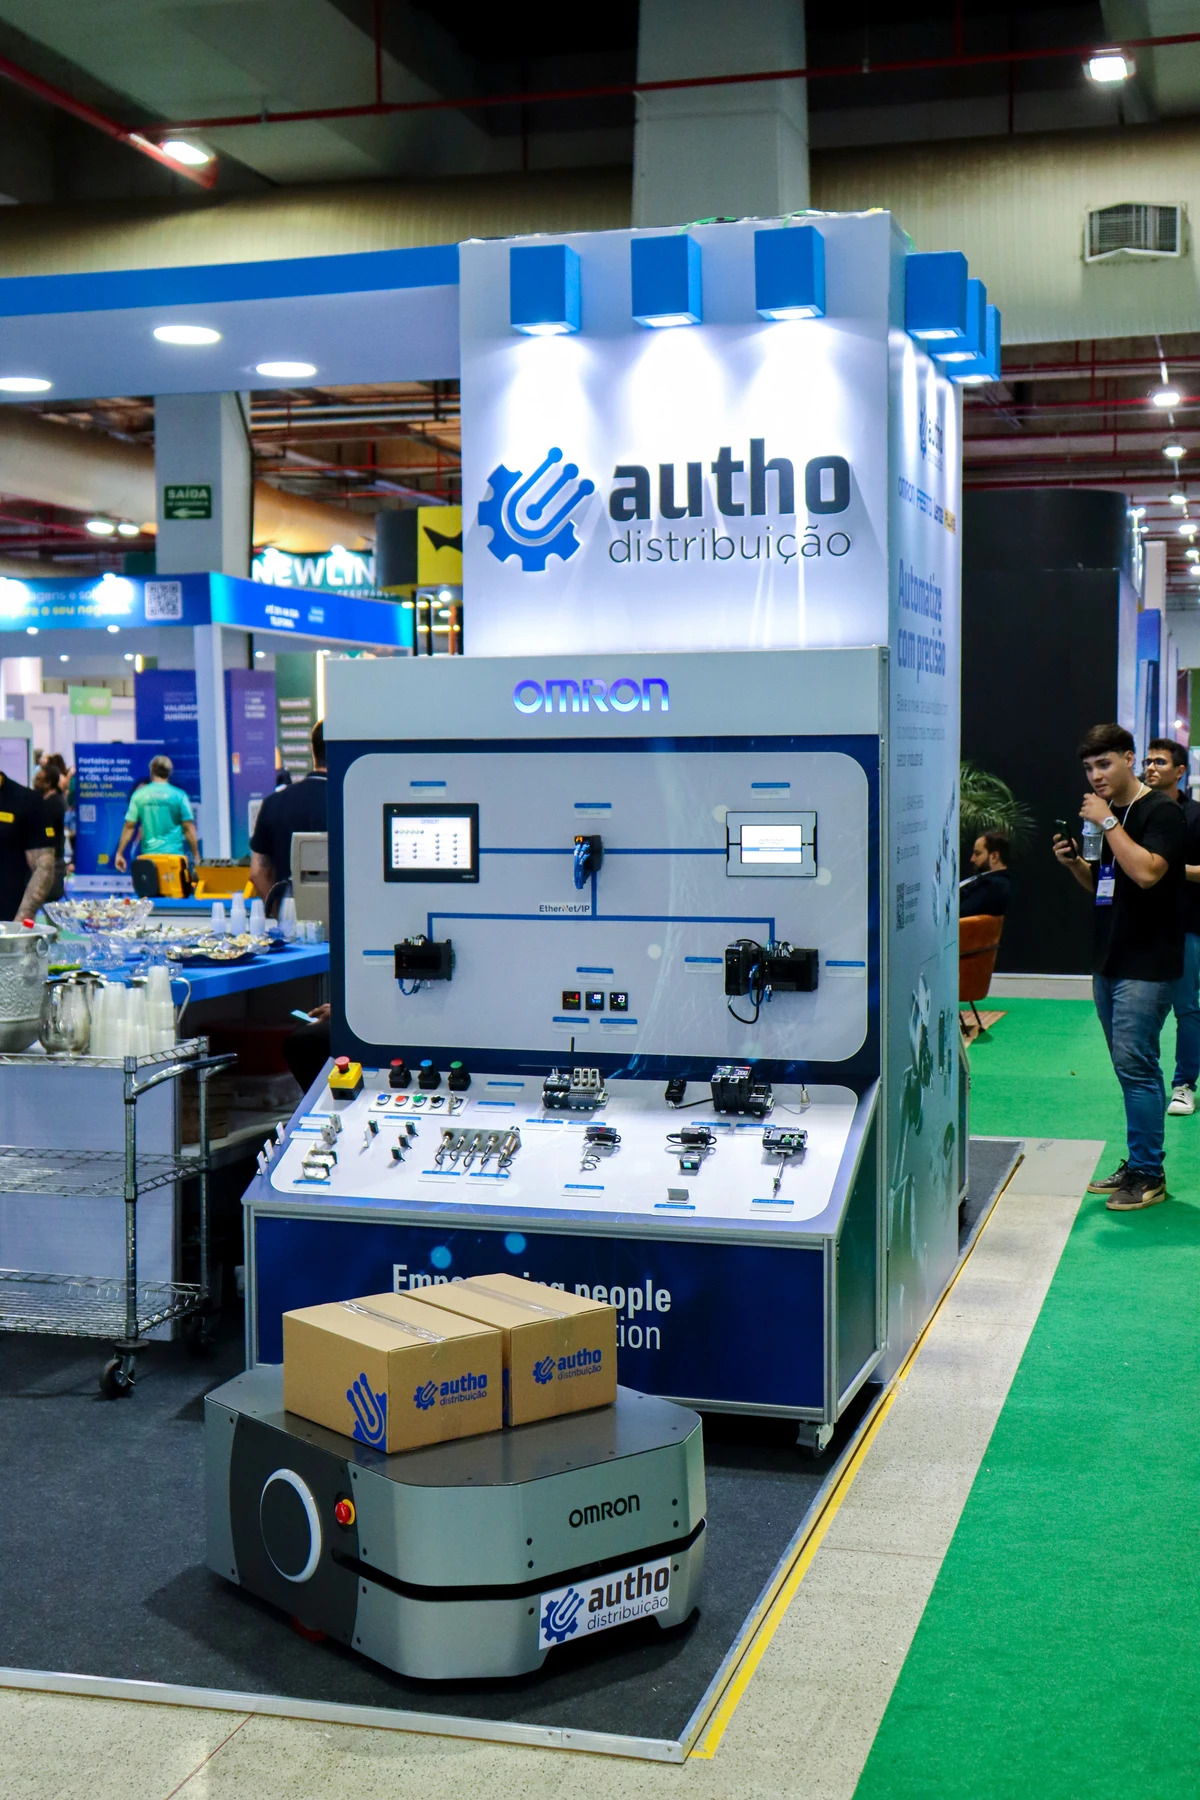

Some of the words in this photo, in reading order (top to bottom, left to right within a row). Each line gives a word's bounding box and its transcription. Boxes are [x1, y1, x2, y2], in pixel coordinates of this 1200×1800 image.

[167, 486, 209, 499] SAÍDA
[608, 438, 850, 521] autho
[608, 524, 851, 564] distribuição
[898, 558, 942, 623] Automatize
[512, 677, 670, 713] OMRON
[539, 904, 590, 913] EtherNet/IP
[616, 1315, 661, 1350] ion
[557, 1348, 602, 1371] autho
[557, 1364, 602, 1380] distribuição
[440, 1372, 487, 1396] autho
[440, 1390, 487, 1406] distribuição
[568, 1494, 640, 1528] OMRON
[588, 1566, 670, 1613] autho
[587, 1595, 668, 1630] distribuição
